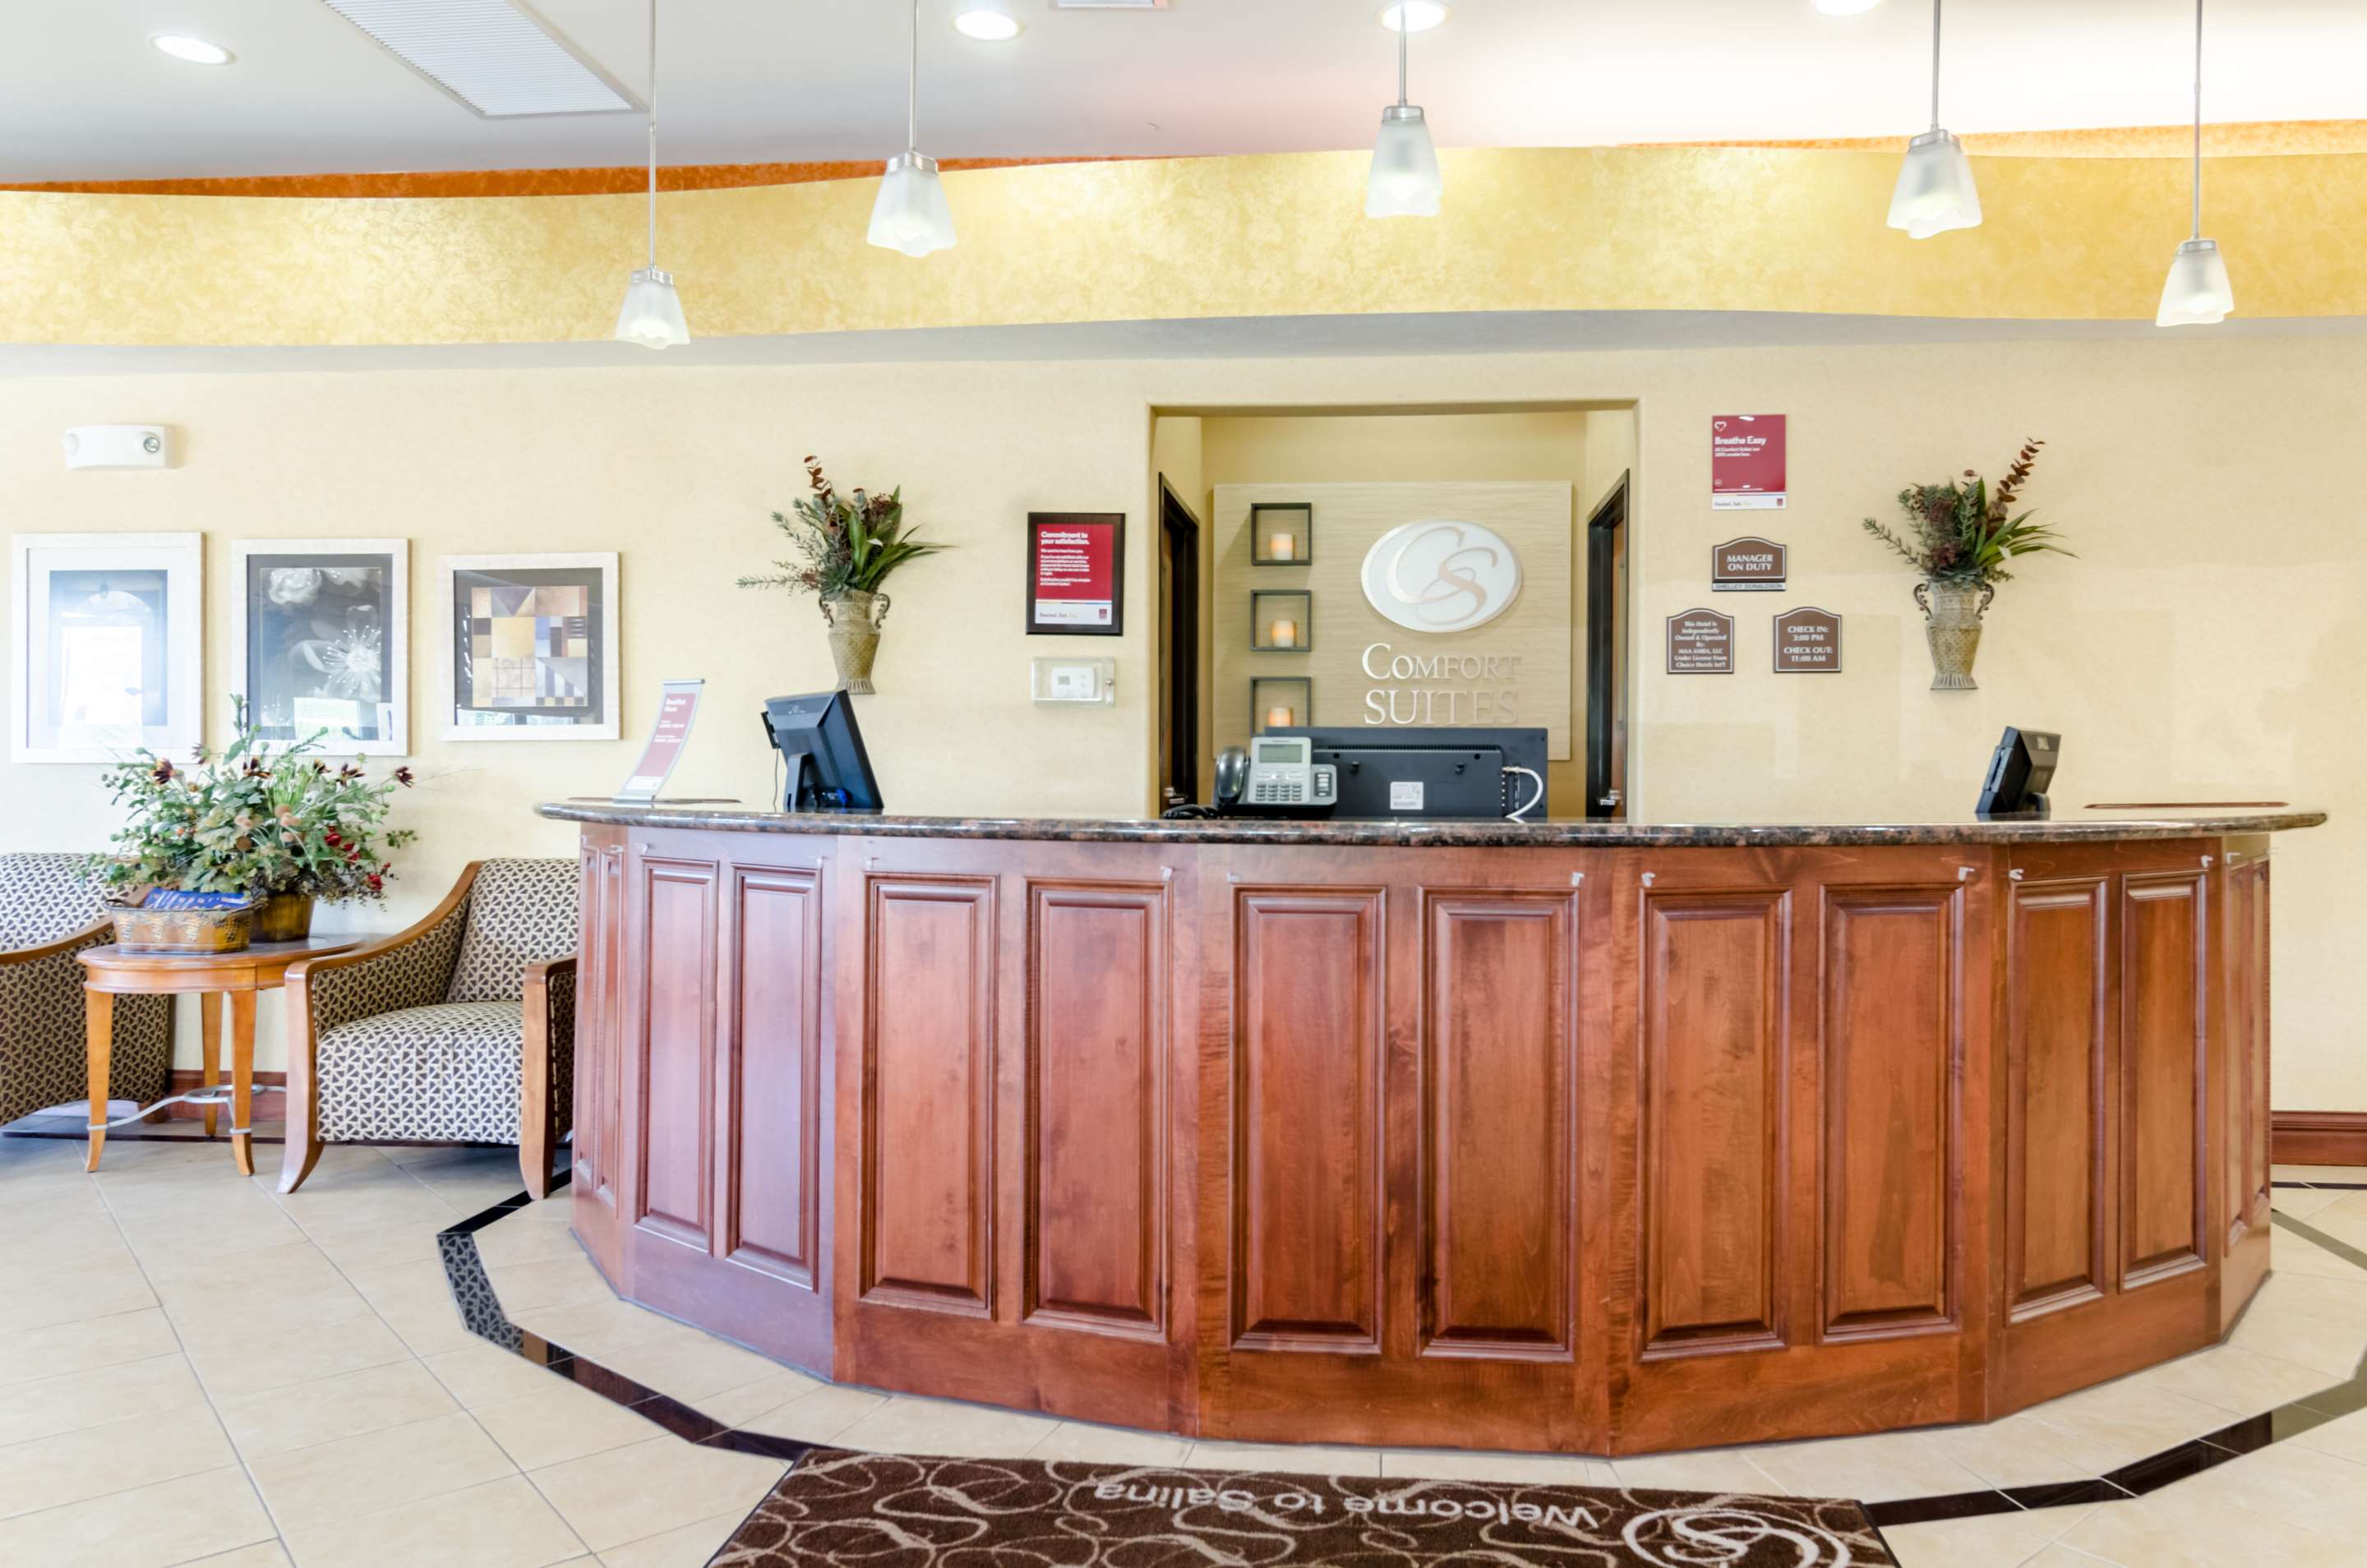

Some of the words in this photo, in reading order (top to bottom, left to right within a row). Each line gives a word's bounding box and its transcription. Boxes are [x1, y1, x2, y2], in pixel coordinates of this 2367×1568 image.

[1714, 436, 1746, 445] Breathe
[1746, 436, 1767, 446] Easy
[1727, 554, 1774, 563] MANAGER
[1728, 563, 1743, 571] ON
[1746, 563, 1773, 571] DUTY
[1361, 643, 1522, 680] COMFORT
[1812, 646, 1834, 654] OUT:
[1363, 689, 1519, 725] SUITES
[1093, 1480, 1257, 1512] Salina
[1273, 1492, 1327, 1515] to
[1343, 1488, 1600, 1529] Welcome
